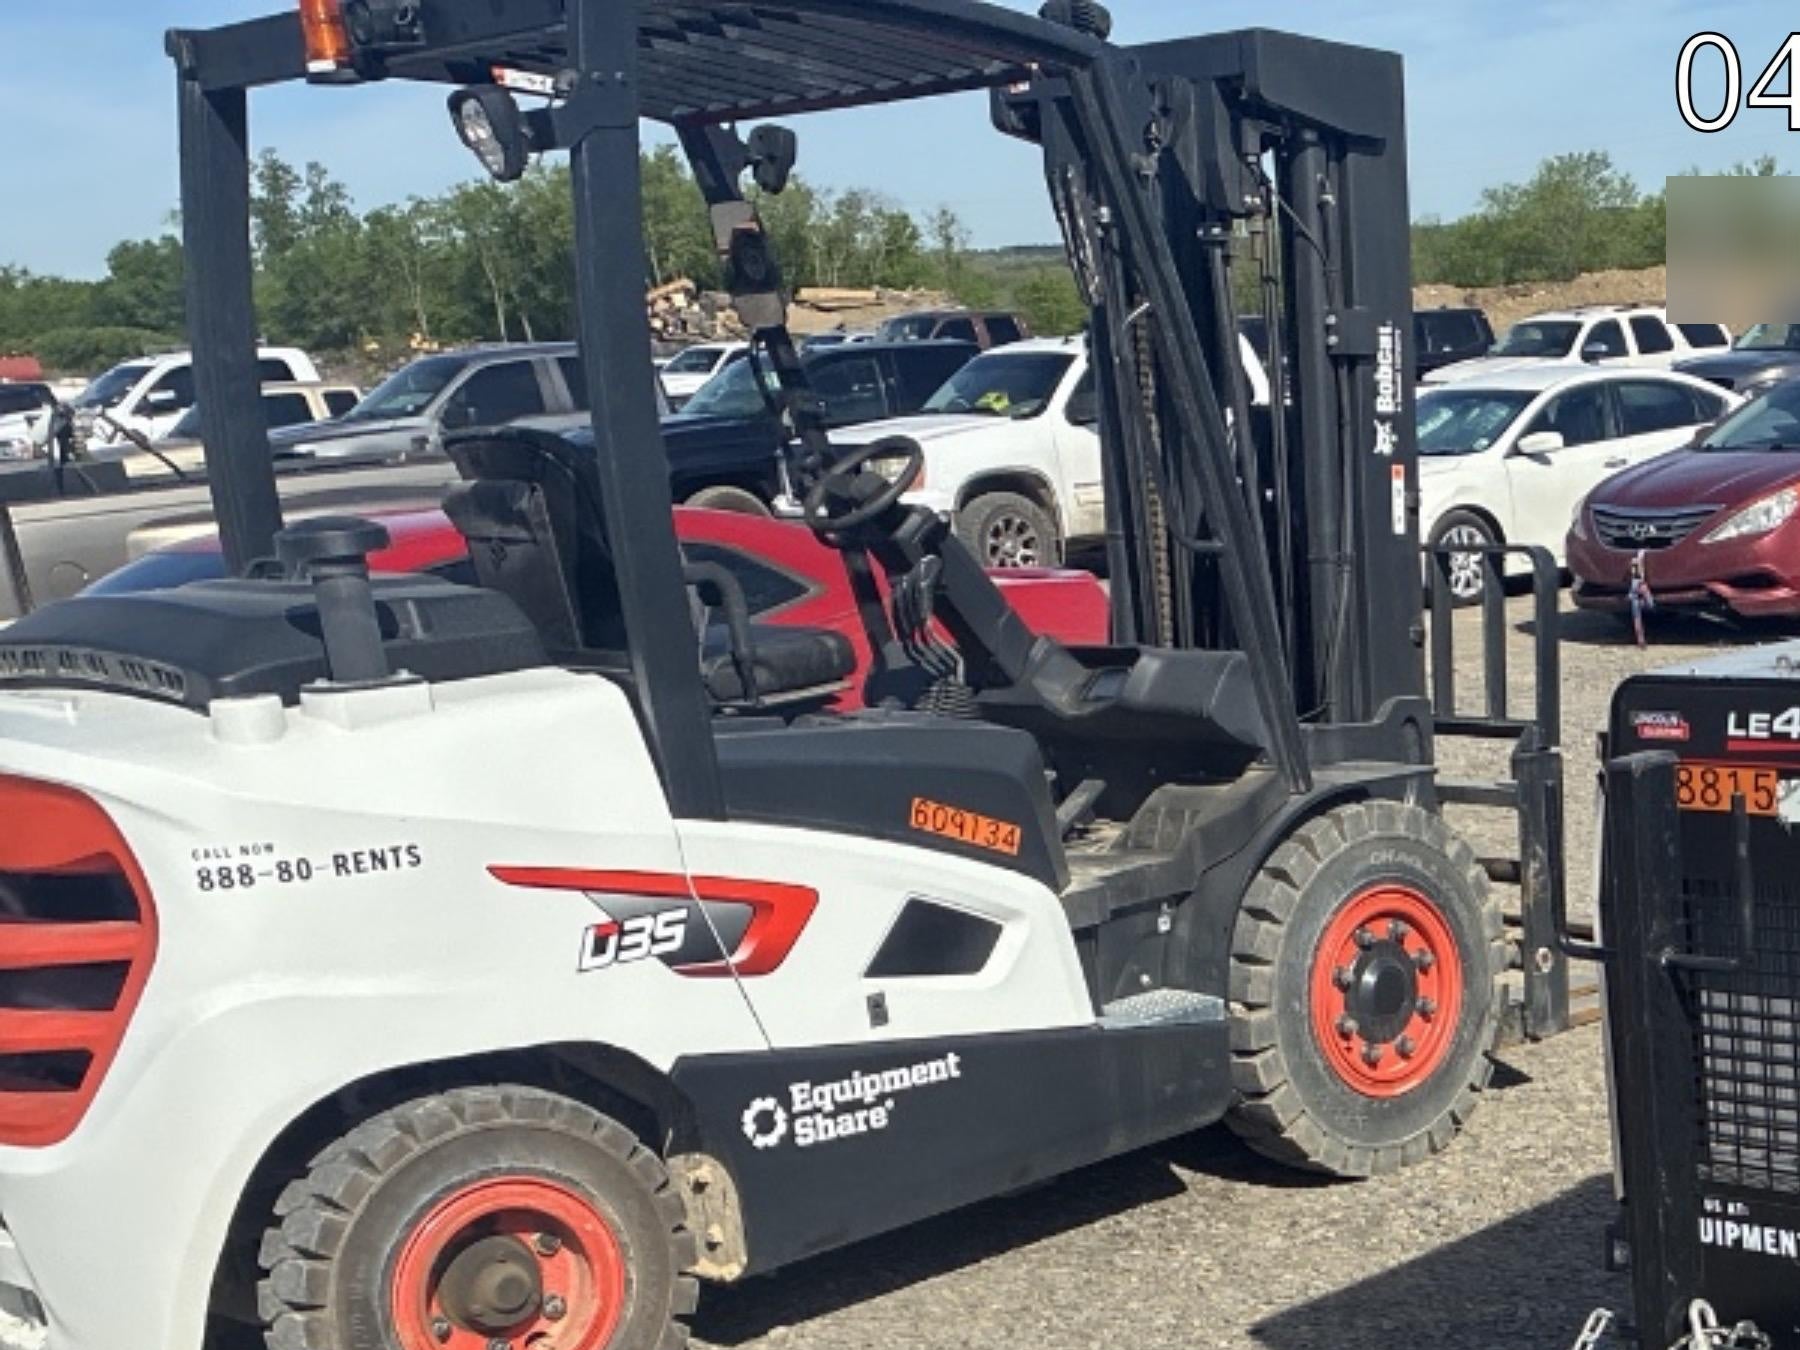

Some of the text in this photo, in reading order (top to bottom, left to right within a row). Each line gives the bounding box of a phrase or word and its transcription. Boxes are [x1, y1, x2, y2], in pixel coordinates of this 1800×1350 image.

[912, 799, 1018, 850] 609134
[191, 847, 232, 862] CALL
[196, 843, 423, 892] 888-80-RENTS
[788, 1051, 961, 1113] Equipment
[793, 1103, 892, 1148] Share
